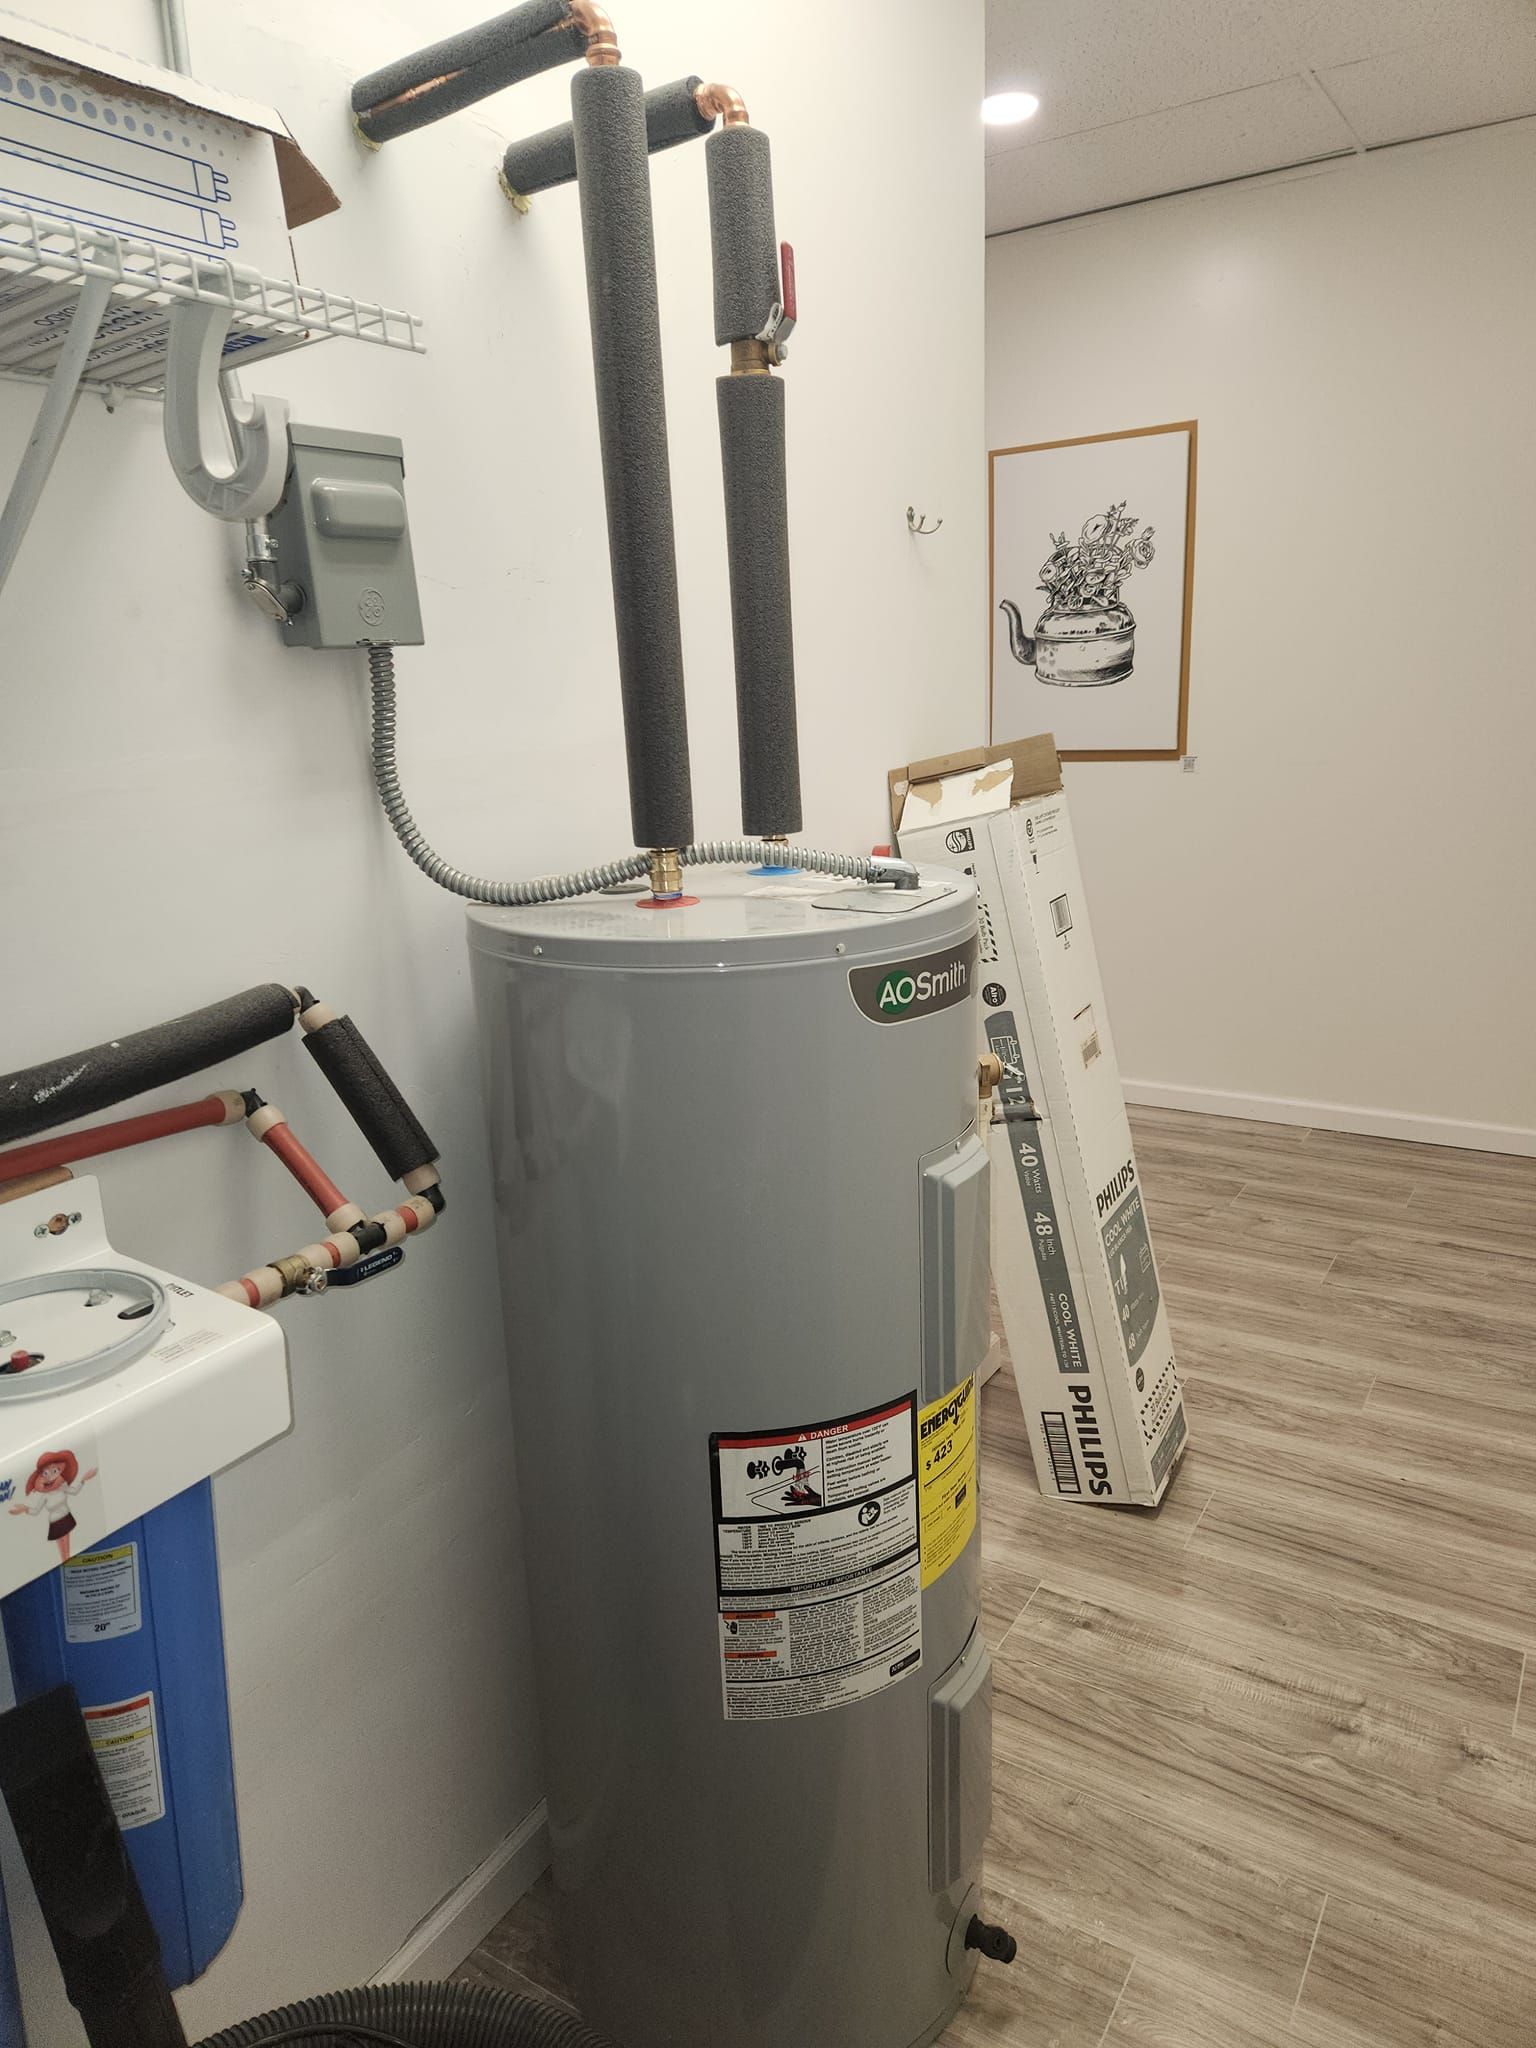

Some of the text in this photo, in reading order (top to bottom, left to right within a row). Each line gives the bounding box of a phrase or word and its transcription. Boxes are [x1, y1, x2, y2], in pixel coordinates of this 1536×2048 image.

[1019, 1142, 1042, 1194] 40 Watts
[1096, 1159, 1135, 1218] PHILIPS
[1034, 1212, 1056, 1256] 48 Inch
[1105, 1196, 1140, 1247] COOL WHITE
[364, 1254, 392, 1271] LEGEND
[1058, 1293, 1082, 1368] COOL WHITE
[810, 1424, 849, 1440] DANGER
[934, 1439, 953, 1464] 423
[1068, 1386, 1112, 1496] PHILIPS
[790, 1580, 829, 1592] IMPORTANT
[834, 1567, 873, 1582] IMPORTANTE
[106, 1735, 135, 1745] CAUTION
